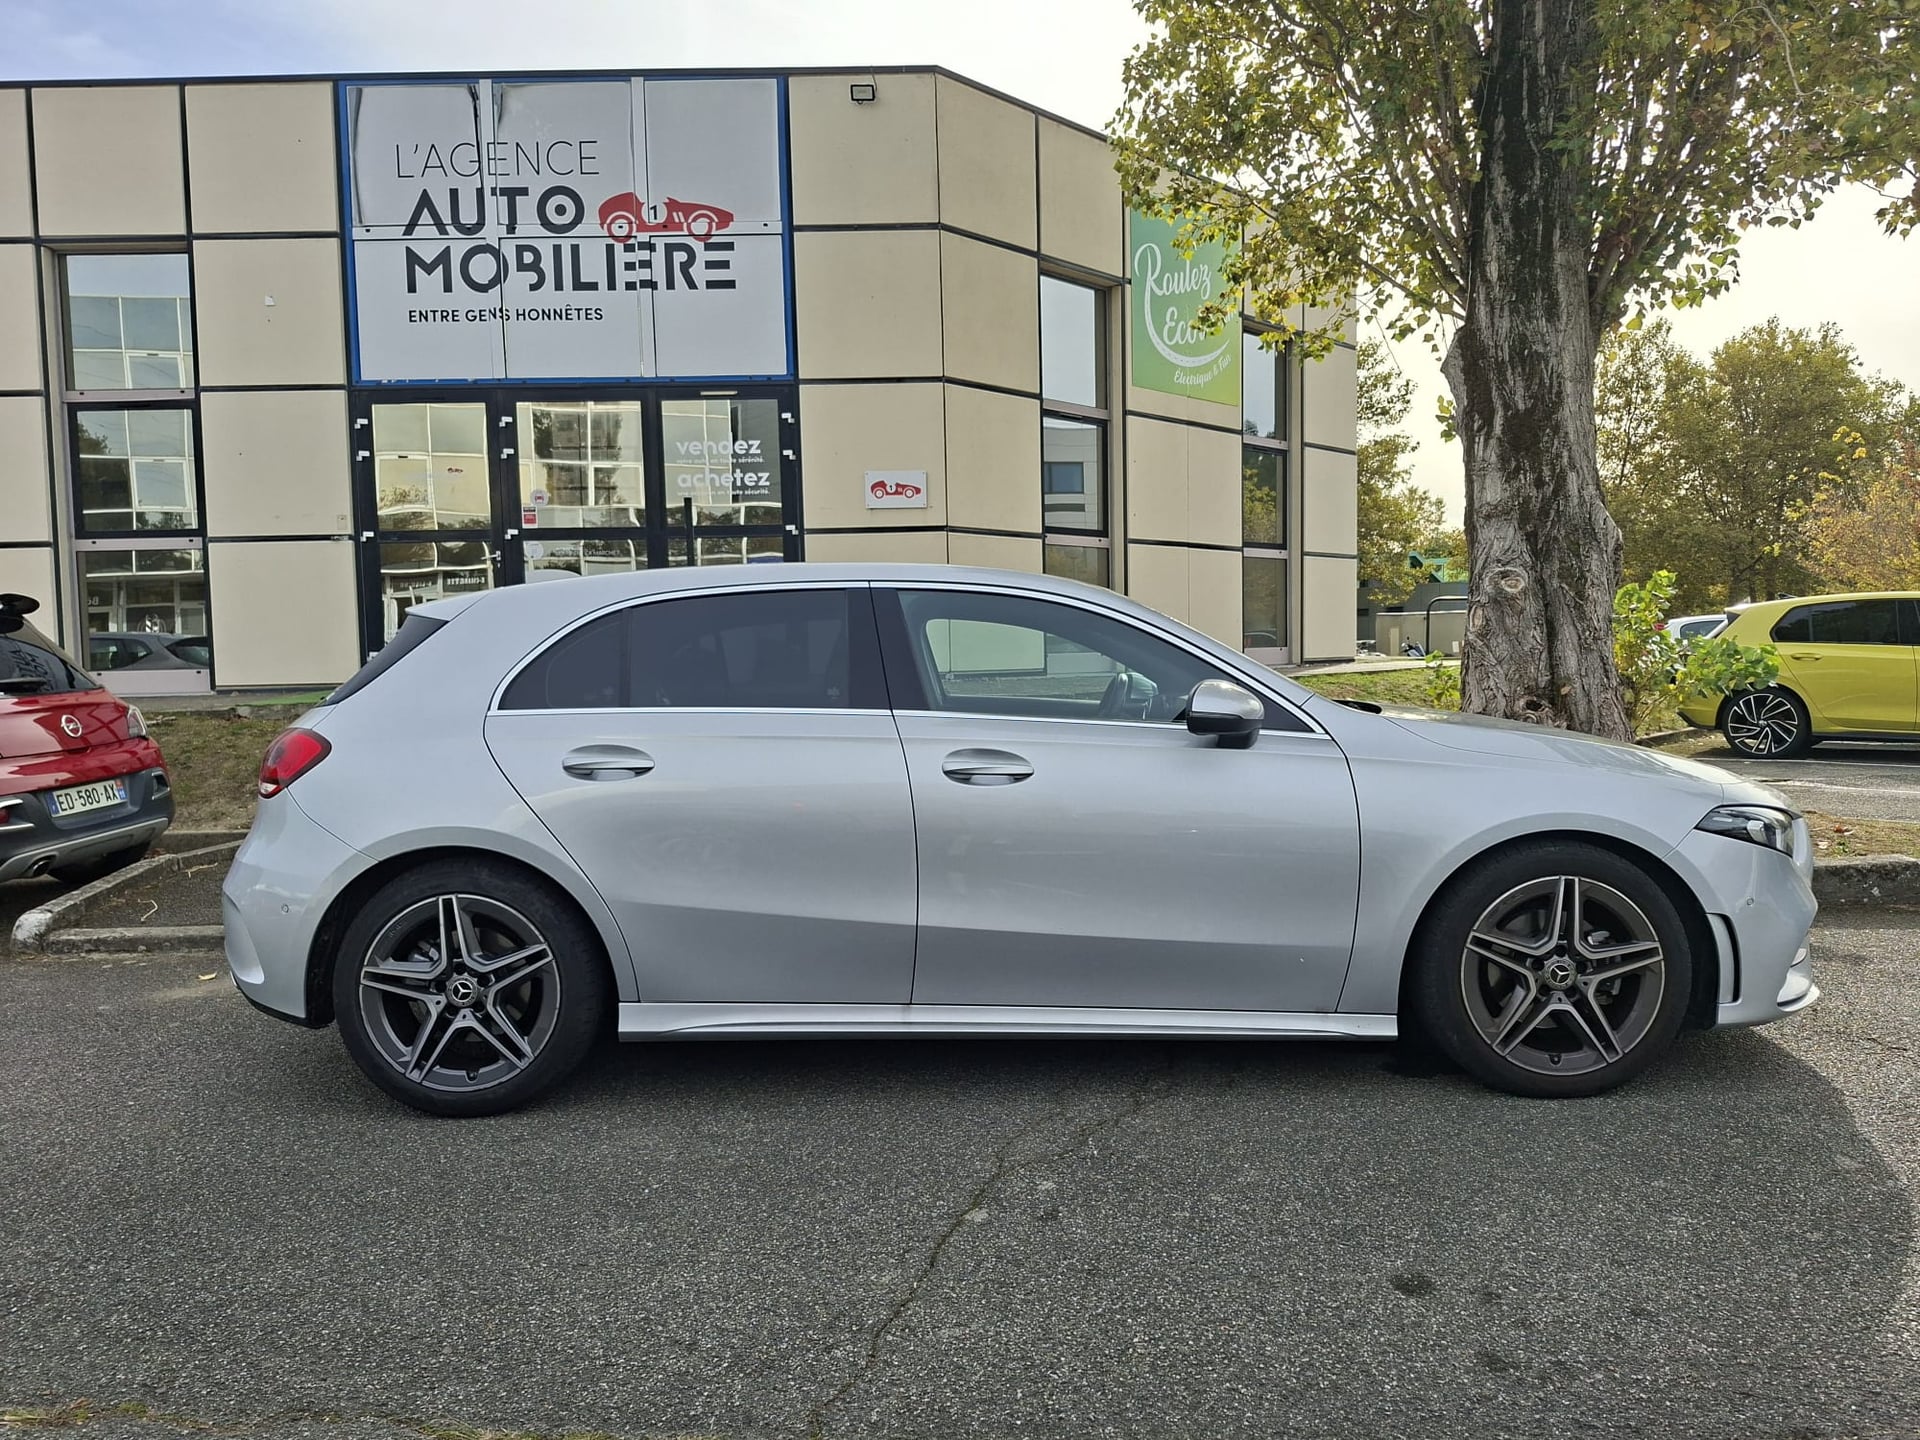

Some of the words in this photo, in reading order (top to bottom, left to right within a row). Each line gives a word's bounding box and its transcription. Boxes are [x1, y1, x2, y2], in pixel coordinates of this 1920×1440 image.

[396, 141, 600, 178] L'AGENCE
[402, 185, 585, 236] AUTO
[1134, 243, 1212, 300] Roulez
[408, 309, 460, 323] ENTRE
[465, 307, 511, 322] GENS
[516, 304, 604, 321] HONNÊTES
[676, 440, 761, 455] vendez
[677, 469, 770, 487] achetez
[56, 783, 118, 812] ED-580-AX
